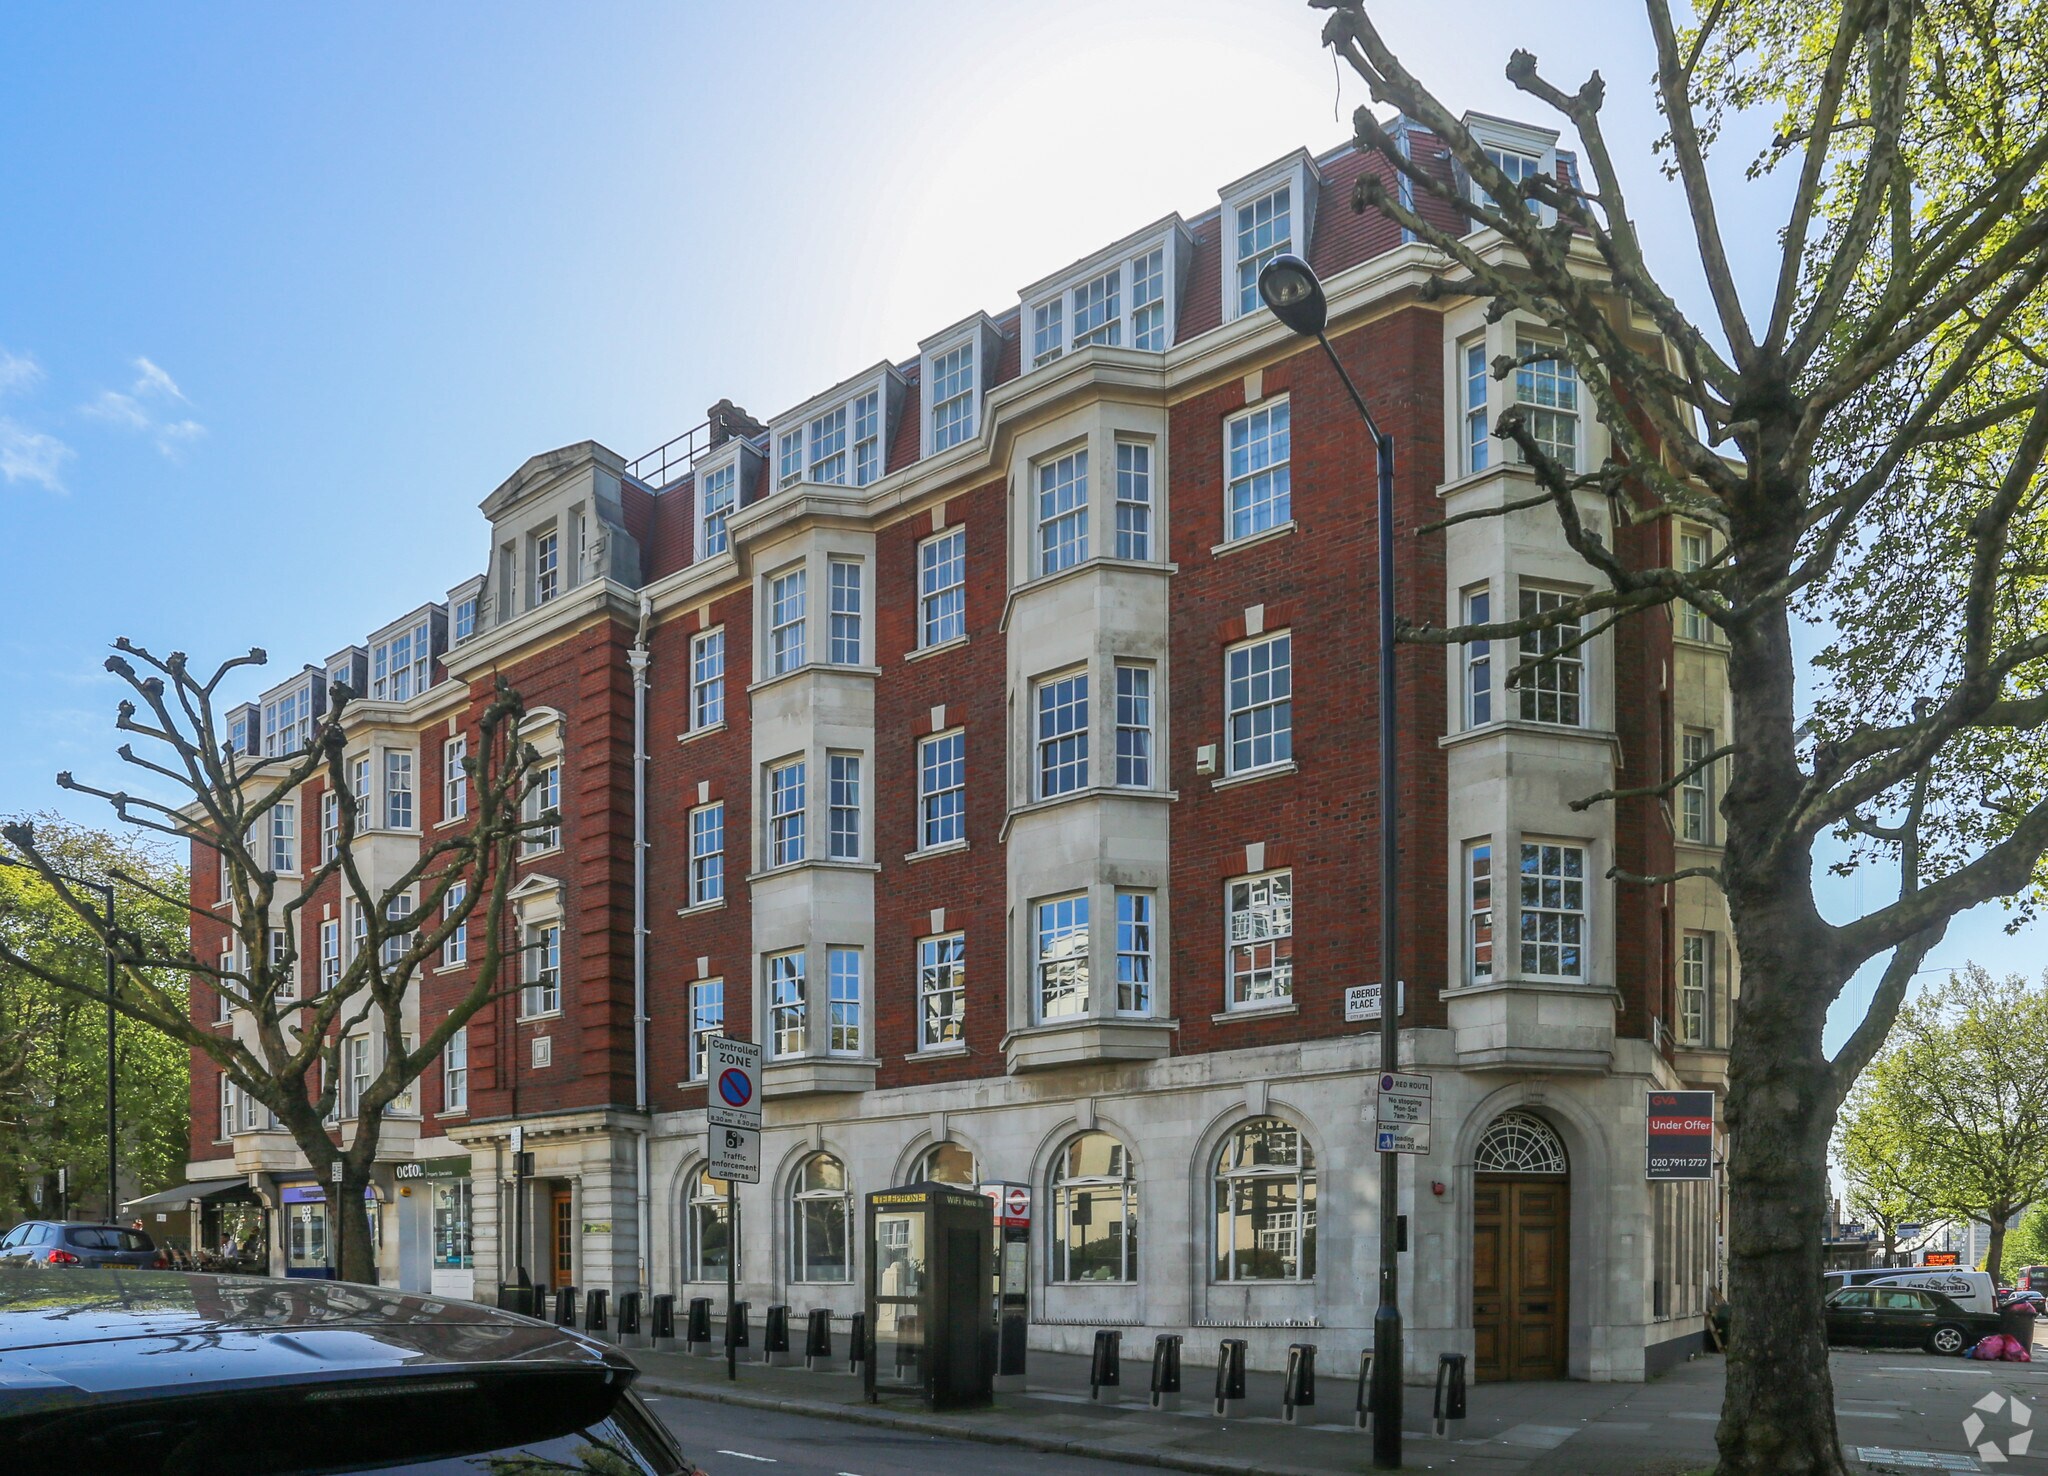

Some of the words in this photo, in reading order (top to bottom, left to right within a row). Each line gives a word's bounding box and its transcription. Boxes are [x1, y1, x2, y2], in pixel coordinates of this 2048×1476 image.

[1351, 988, 1381, 999] ABERDE
[1350, 999, 1374, 1009] PLACE
[713, 1040, 758, 1056] Controlled
[719, 1053, 752, 1067] ZONE
[1409, 1082, 1429, 1090] ROUTE
[1398, 1098, 1422, 1106] stopping
[1652, 1095, 1677, 1106] GVA
[1378, 1123, 1400, 1131] Except
[1652, 1120, 1682, 1130] Under
[1684, 1120, 1710, 1130] Offer
[723, 1151, 747, 1161] Traffic
[711, 1160, 757, 1172] enforcement
[1651, 1158, 1668, 1167] 020
[1669, 1158, 1686, 1167] 7911
[1688, 1158, 1707, 1167] 2727
[719, 1170, 749, 1180] cameras
[876, 1193, 922, 1203] TELEPHONE
[946, 1195, 961, 1204] WiFi
[963, 1198, 976, 1207] here
